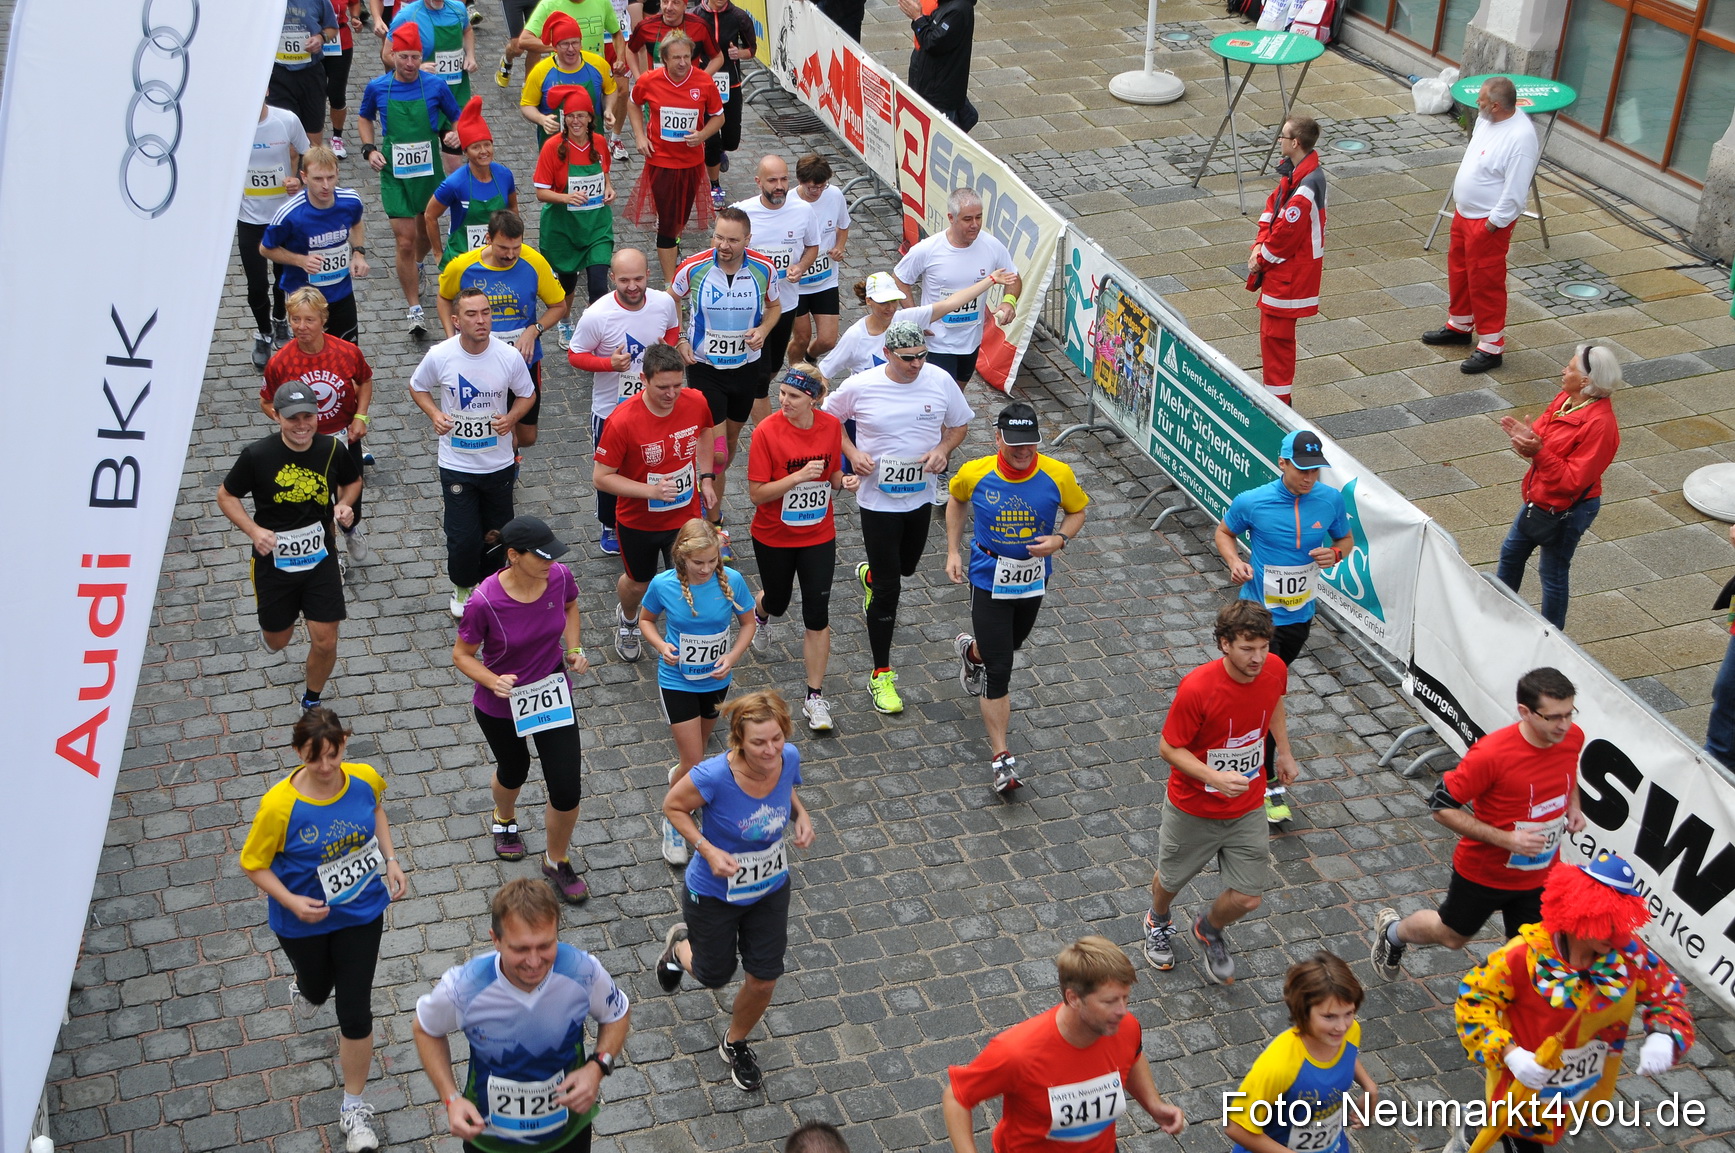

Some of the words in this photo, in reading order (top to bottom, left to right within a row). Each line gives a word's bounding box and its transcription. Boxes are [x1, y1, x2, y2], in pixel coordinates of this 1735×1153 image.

[285, 41, 300, 52] 66
[664, 116, 694, 129] 2087
[397, 151, 428, 165] 2067
[251, 174, 276, 186] 631
[309, 229, 347, 246] HUBER
[323, 254, 346, 272] 836
[709, 340, 746, 354] 2914
[300, 370, 344, 390] NISHER
[624, 382, 643, 396] 28
[1182, 361, 1250, 428] Event-Leit-Systeme
[88, 302, 159, 509] BKK
[454, 420, 492, 438] 2831
[1160, 382, 1190, 422] Mehr
[1192, 411, 1250, 478] Sicherheit
[460, 440, 488, 448] Christian
[1158, 408, 1174, 436] für
[1176, 425, 1192, 452] Ihr
[1194, 442, 1232, 490] Event!
[884, 466, 923, 482] 2401
[1154, 443, 1170, 466] Miet
[1172, 459, 1177, 472] &
[1178, 466, 1203, 496] Service
[1204, 488, 1220, 514] Line:
[788, 490, 826, 510] 2393
[278, 534, 320, 556] 2920
[290, 557, 316, 566] Markus
[1000, 566, 1042, 584] 3402
[1276, 576, 1307, 594] 102
[1340, 596, 1362, 621] Service
[1364, 614, 1385, 638] GmbH
[686, 640, 726, 662] 2760
[55, 553, 132, 779] Audi
[517, 686, 563, 716] 2761
[538, 714, 552, 724] Iris
[1460, 722, 1473, 742] die
[1214, 751, 1260, 773] 2350
[1577, 739, 1735, 945] SW
[328, 852, 378, 894] 3336
[736, 854, 782, 885] 2124
[1546, 1052, 1598, 1084] 2292
[1060, 1092, 1118, 1128] 3417
